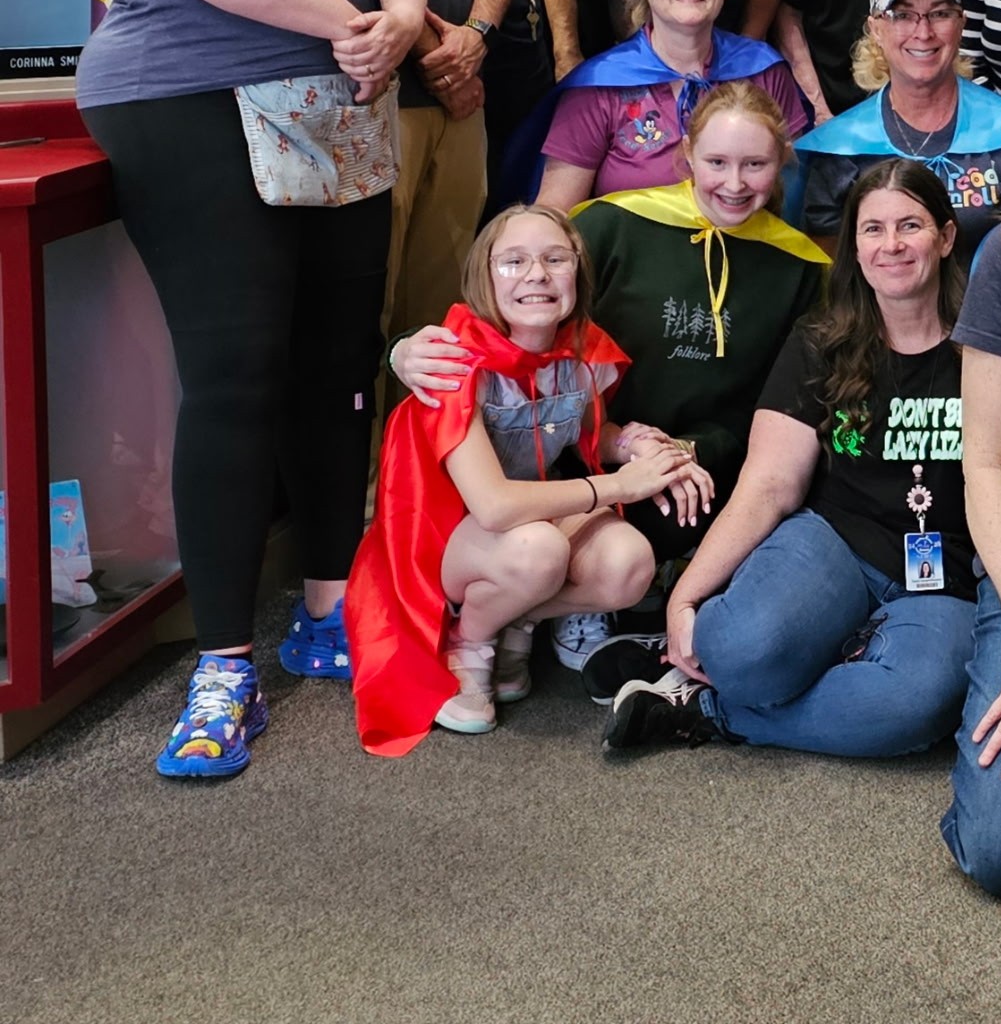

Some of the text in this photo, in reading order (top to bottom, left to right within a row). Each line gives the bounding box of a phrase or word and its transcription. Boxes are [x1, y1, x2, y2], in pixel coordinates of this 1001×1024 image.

[9, 55, 79, 69] CORINNA SMI
[948, 159, 999, 191] read
[667, 345, 711, 361] folklore
[882, 430, 930, 461] LAZY
